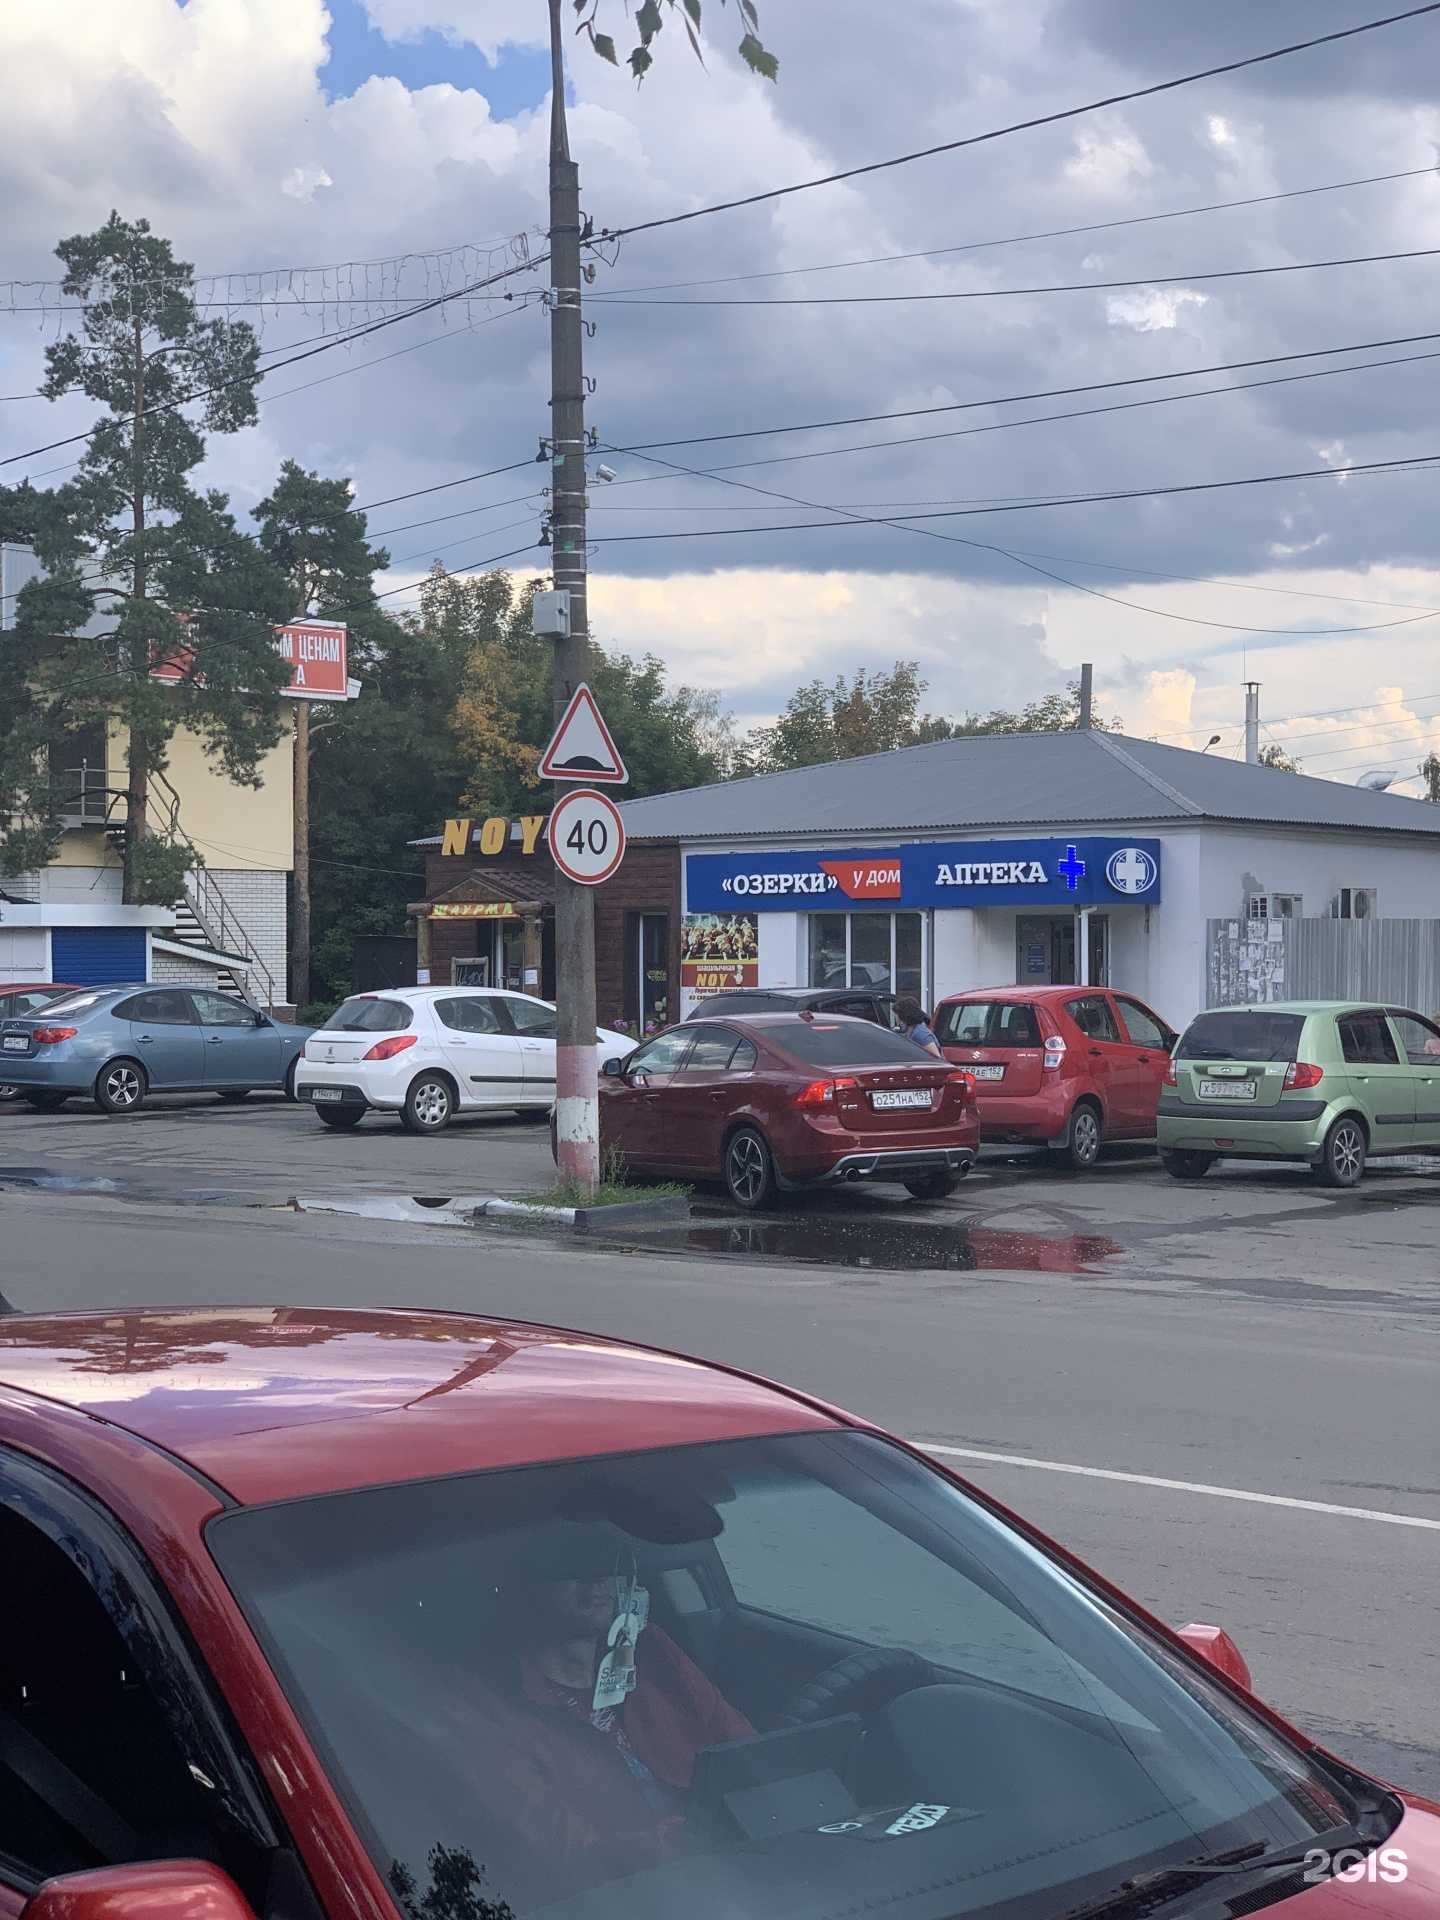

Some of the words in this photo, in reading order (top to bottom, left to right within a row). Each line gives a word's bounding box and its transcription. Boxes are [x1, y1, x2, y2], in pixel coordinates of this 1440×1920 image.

[298, 634, 340, 663] ЦЕНАМ
[566, 819, 608, 855] 40
[722, 872, 838, 895] «ОЗЕРКИ»
[935, 861, 1049, 885] АПТЕКА
[433, 902, 514, 917] ШАУРМА
[695, 973, 729, 987] NOY
